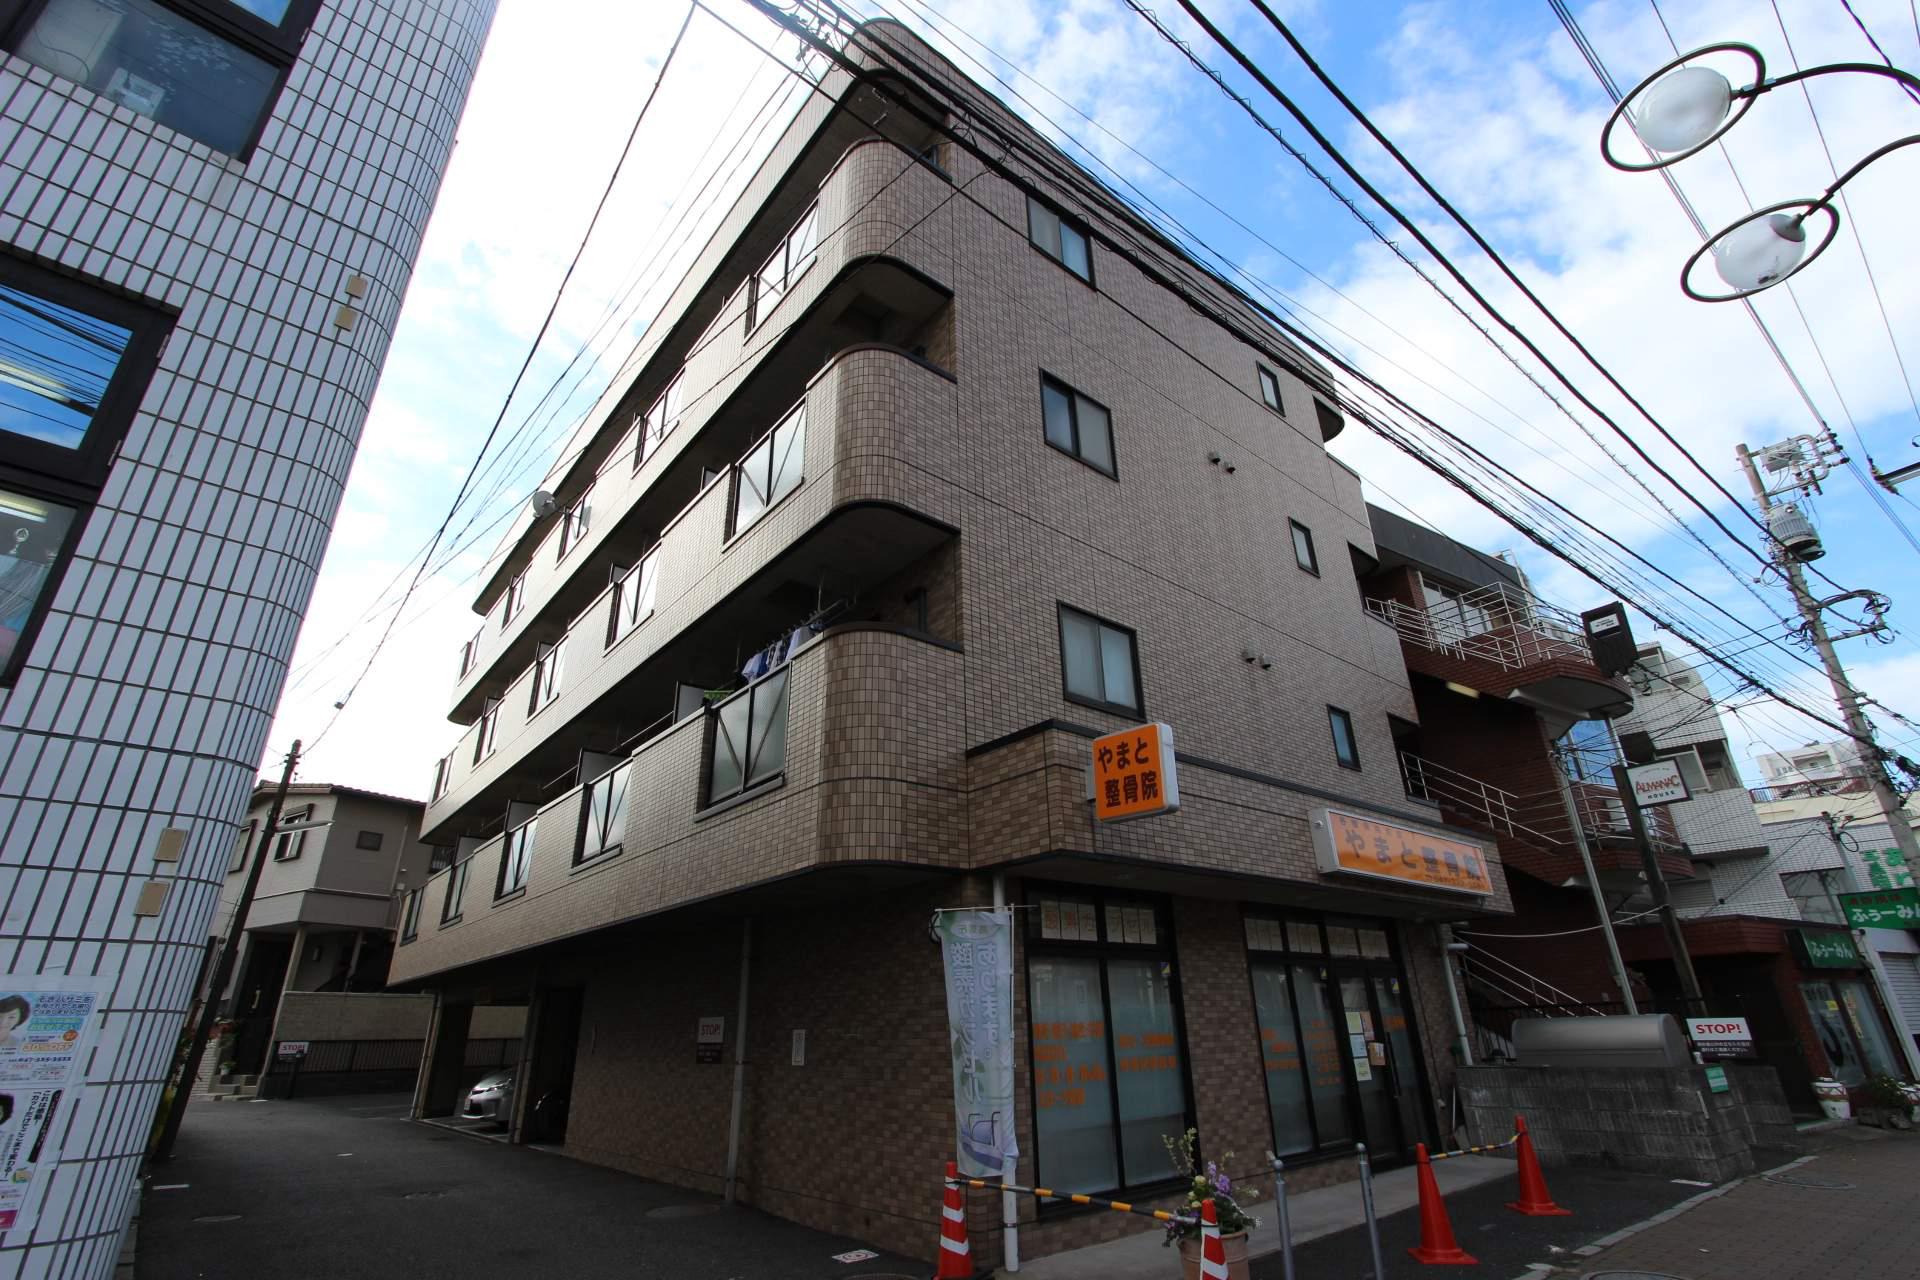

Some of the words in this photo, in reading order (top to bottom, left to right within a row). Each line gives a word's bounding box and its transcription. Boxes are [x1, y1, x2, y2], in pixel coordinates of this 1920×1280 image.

[1098, 737, 1149, 774] やまと
[1104, 770, 1158, 808] 整骨院
[1636, 774, 1680, 794] ALMANAC
[1647, 790, 1676, 800] HOUSE
[1345, 829, 1481, 880] やまと整骨院
[702, 1024, 720, 1035] STOP!
[1695, 1023, 1742, 1034] STOP!
